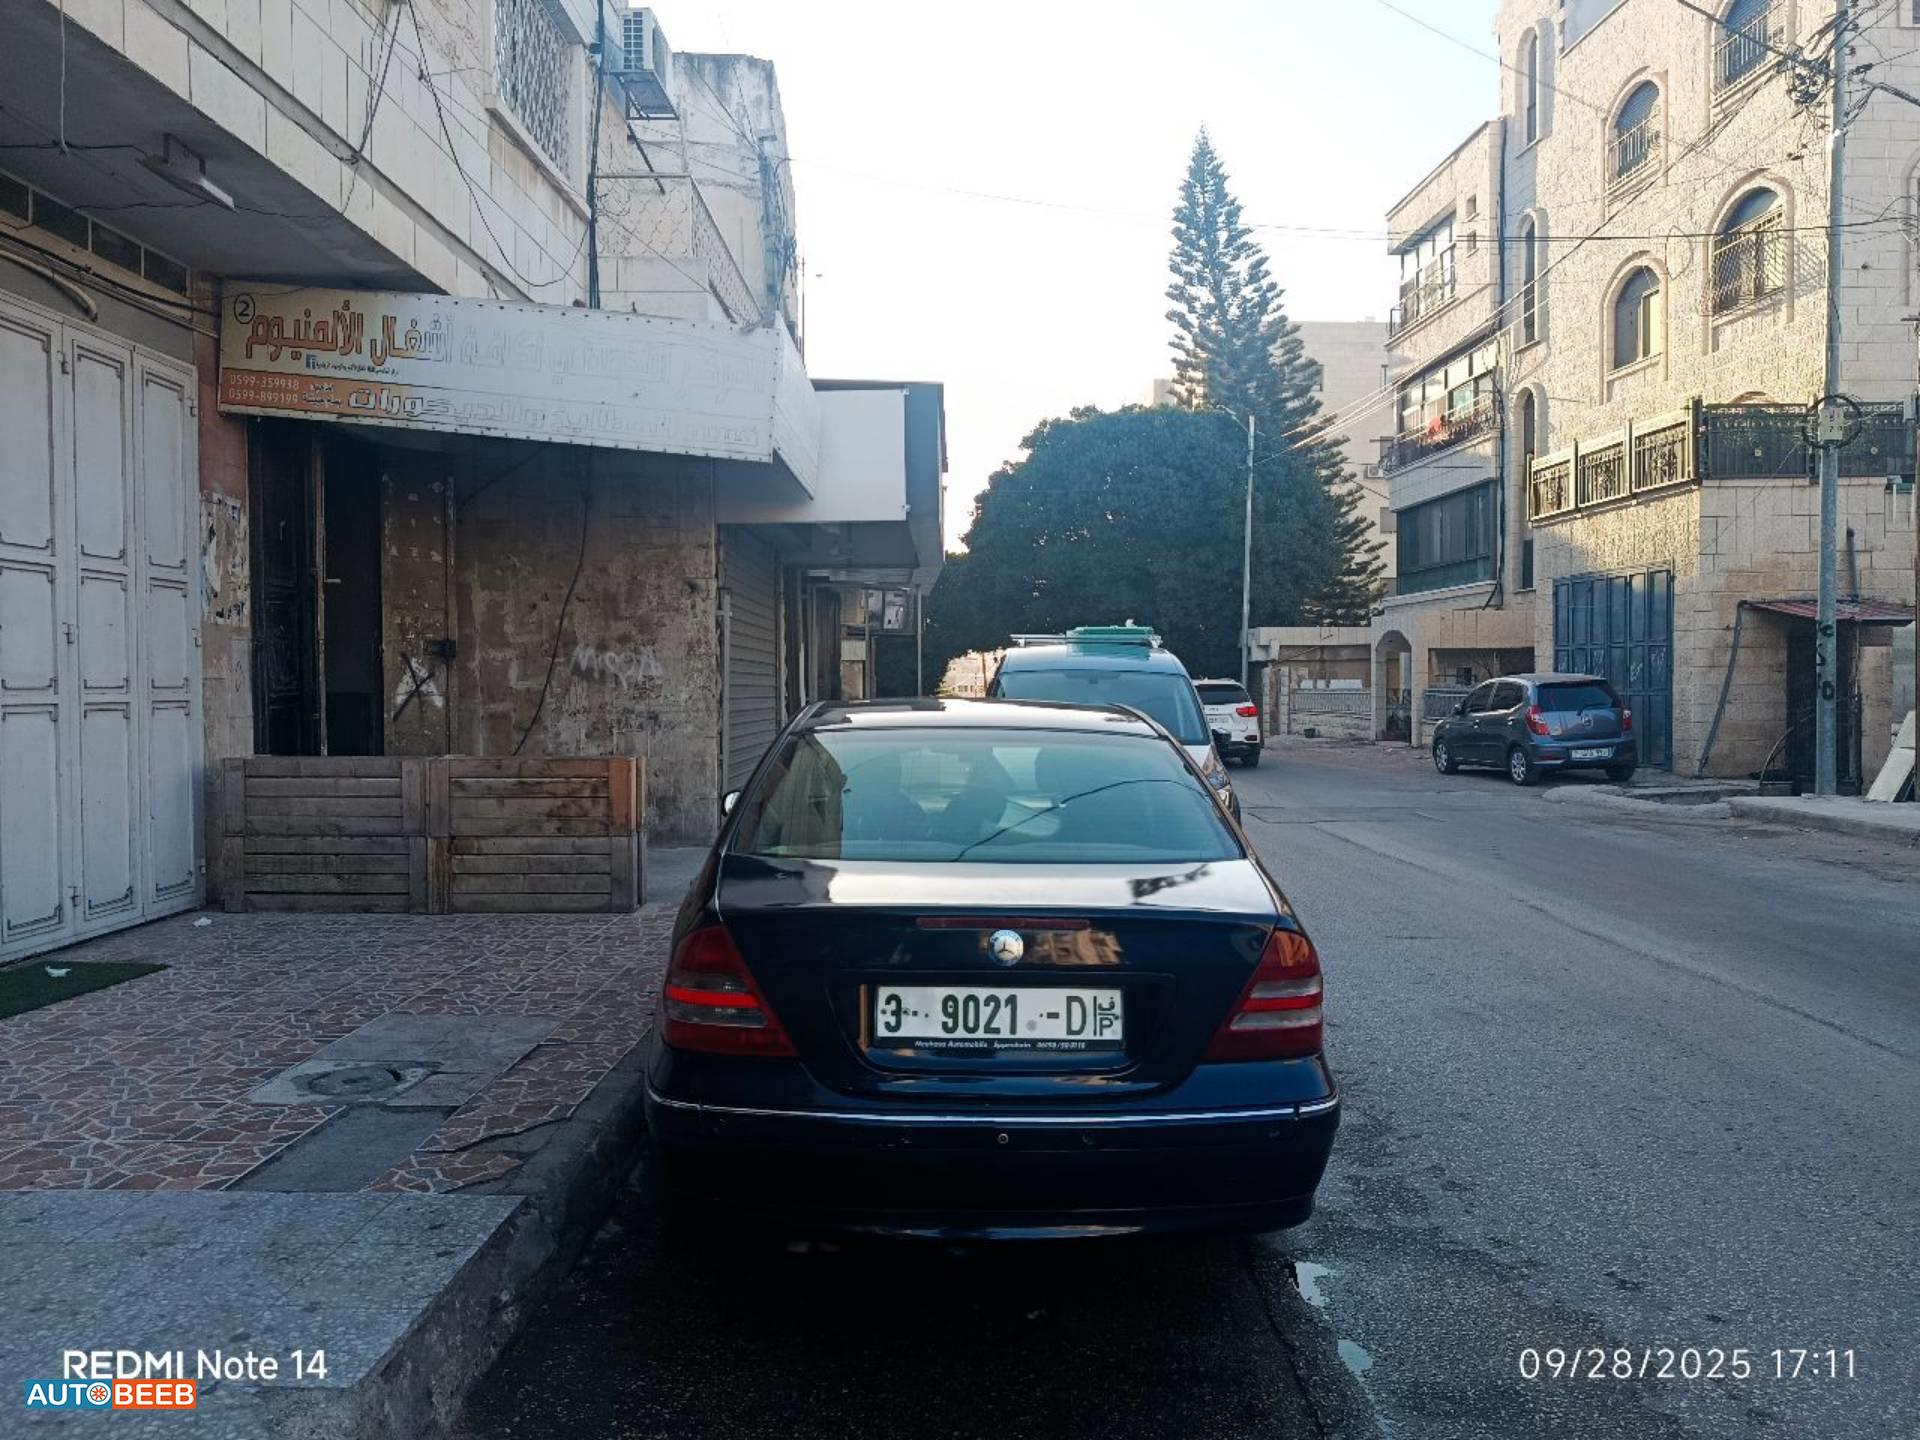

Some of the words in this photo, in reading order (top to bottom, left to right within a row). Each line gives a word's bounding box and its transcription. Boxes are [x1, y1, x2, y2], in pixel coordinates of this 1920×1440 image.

[245, 299, 364, 362] الألمنيوم
[370, 312, 454, 366] أشغال
[883, 993, 903, 1033] 3
[941, 993, 1019, 1036] 9021
